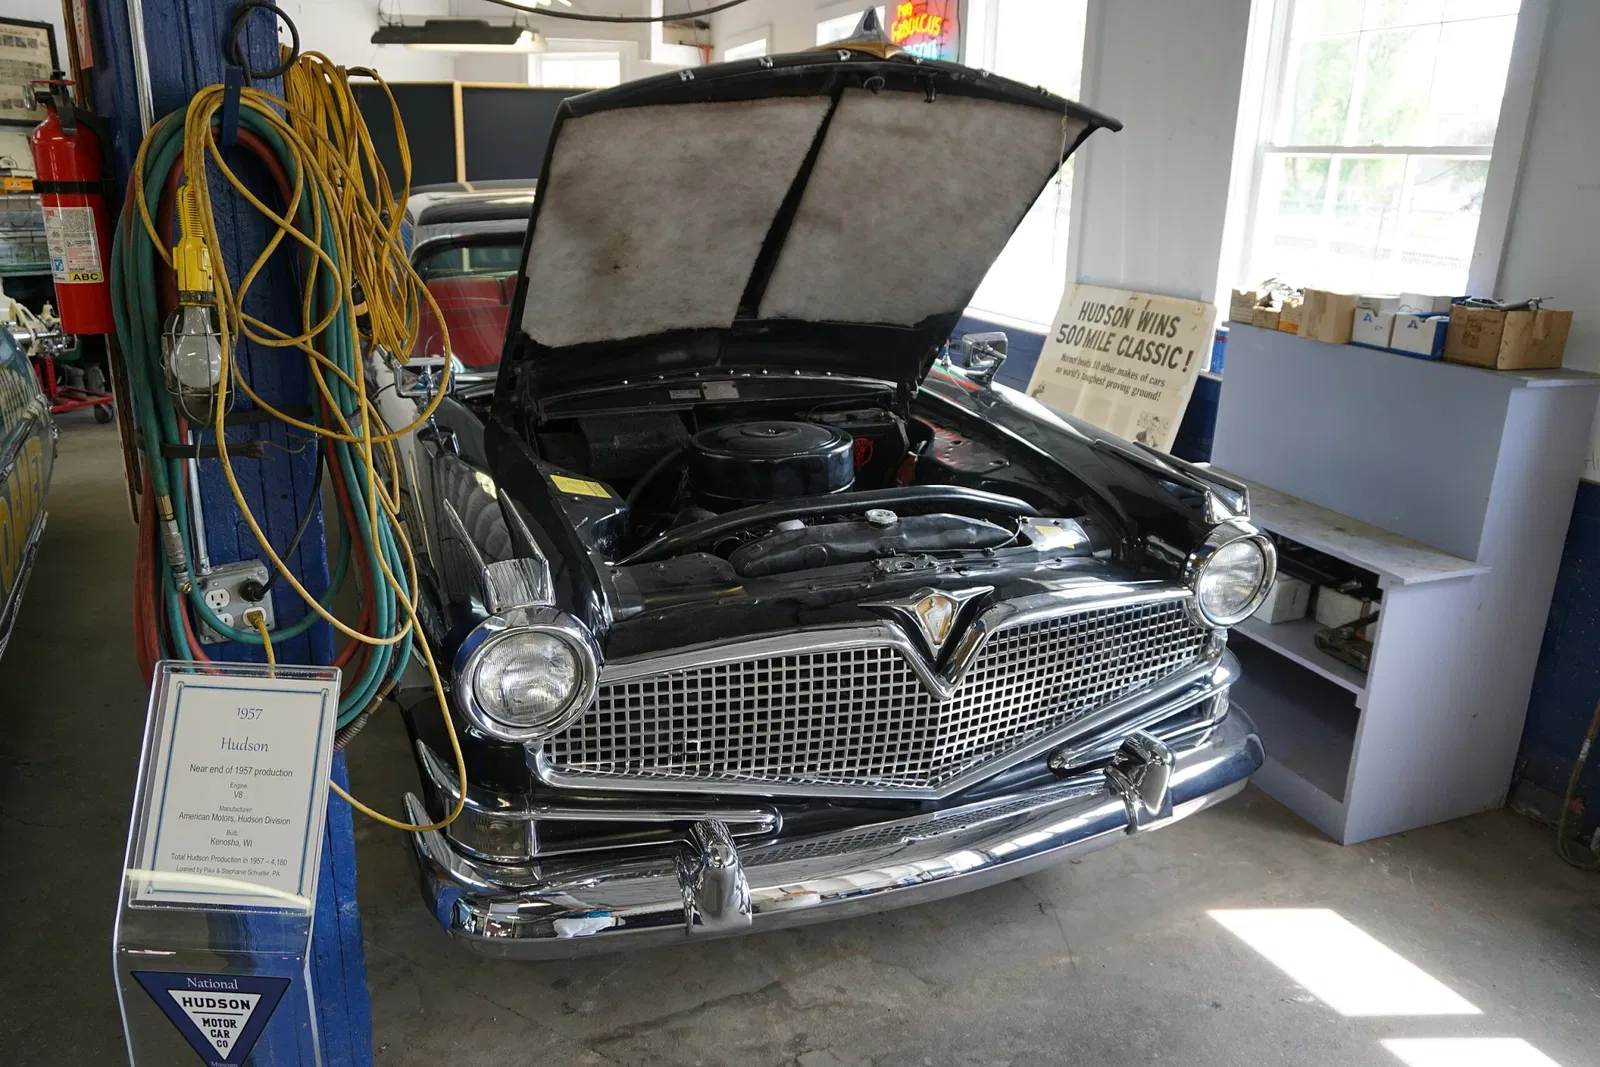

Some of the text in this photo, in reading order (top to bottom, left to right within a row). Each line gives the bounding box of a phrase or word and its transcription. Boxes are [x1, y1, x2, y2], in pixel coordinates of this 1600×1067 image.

[73, 273, 99, 281] ABC
[1078, 301, 1181, 338] HUDSON WINS
[1060, 353, 1077, 364] Hornet
[1077, 358, 1092, 368] beats
[1100, 363, 1117, 374] other
[1117, 368, 1139, 380] makes
[1140, 372, 1150, 381] of
[1149, 376, 1166, 387] cars
[1055, 366, 1162, 401] on world's toughest proving ground!
[236, 707, 263, 720] 1957
[221, 736, 269, 752] Hudson
[189, 764, 293, 778] Near end of 1957 production
[233, 790, 243, 799] V8
[178, 811, 291, 825] American Motors, Hudson Division
[210, 837, 253, 847] Kenosha, WI
[171, 852, 185, 861] Total
[186, 854, 210, 862] Hudson
[210, 855, 241, 864] Production
[242, 856, 249, 864] in
[250, 857, 265, 865] 1957
[175, 865, 196, 873] Loaned
[196, 866, 202, 874] by
[221, 868, 247, 876] Stephanie
[186, 977, 239, 990] National
[181, 996, 251, 1010] HUDSON
[202, 1017, 238, 1029] MOTOR
[210, 1029, 231, 1039] CAR
[216, 1039, 229, 1048] CO
